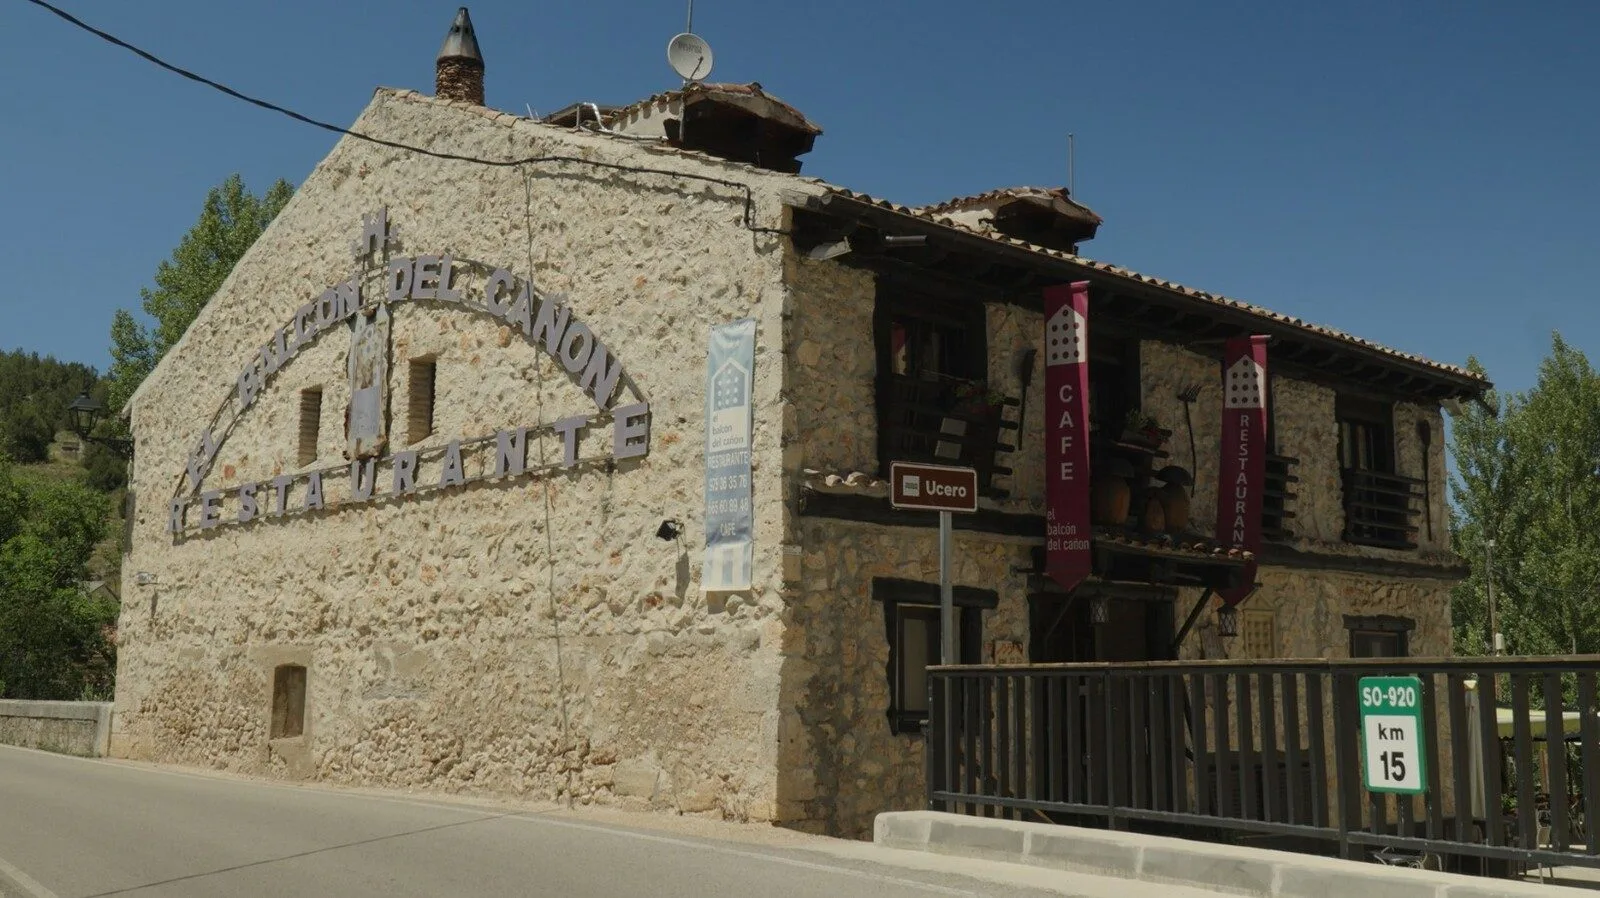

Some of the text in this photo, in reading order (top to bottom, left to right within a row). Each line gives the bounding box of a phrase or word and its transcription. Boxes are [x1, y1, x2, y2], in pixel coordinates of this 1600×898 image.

[237, 272, 360, 407] BALCON
[388, 254, 462, 301] DEL
[486, 268, 623, 409] CAÑON
[1059, 384, 1075, 481] CAFE
[168, 402, 650, 534] RESTAURANTE
[707, 451, 749, 469] RESTAURANTE
[926, 480, 967, 498] Ucero
[1233, 414, 1250, 548] RESTAURAN
[1047, 507, 1056, 521] el
[1048, 538, 1061, 551] del
[1362, 686, 1416, 708] SO-920
[1378, 723, 1404, 741] km
[1380, 751, 1406, 782] 15
